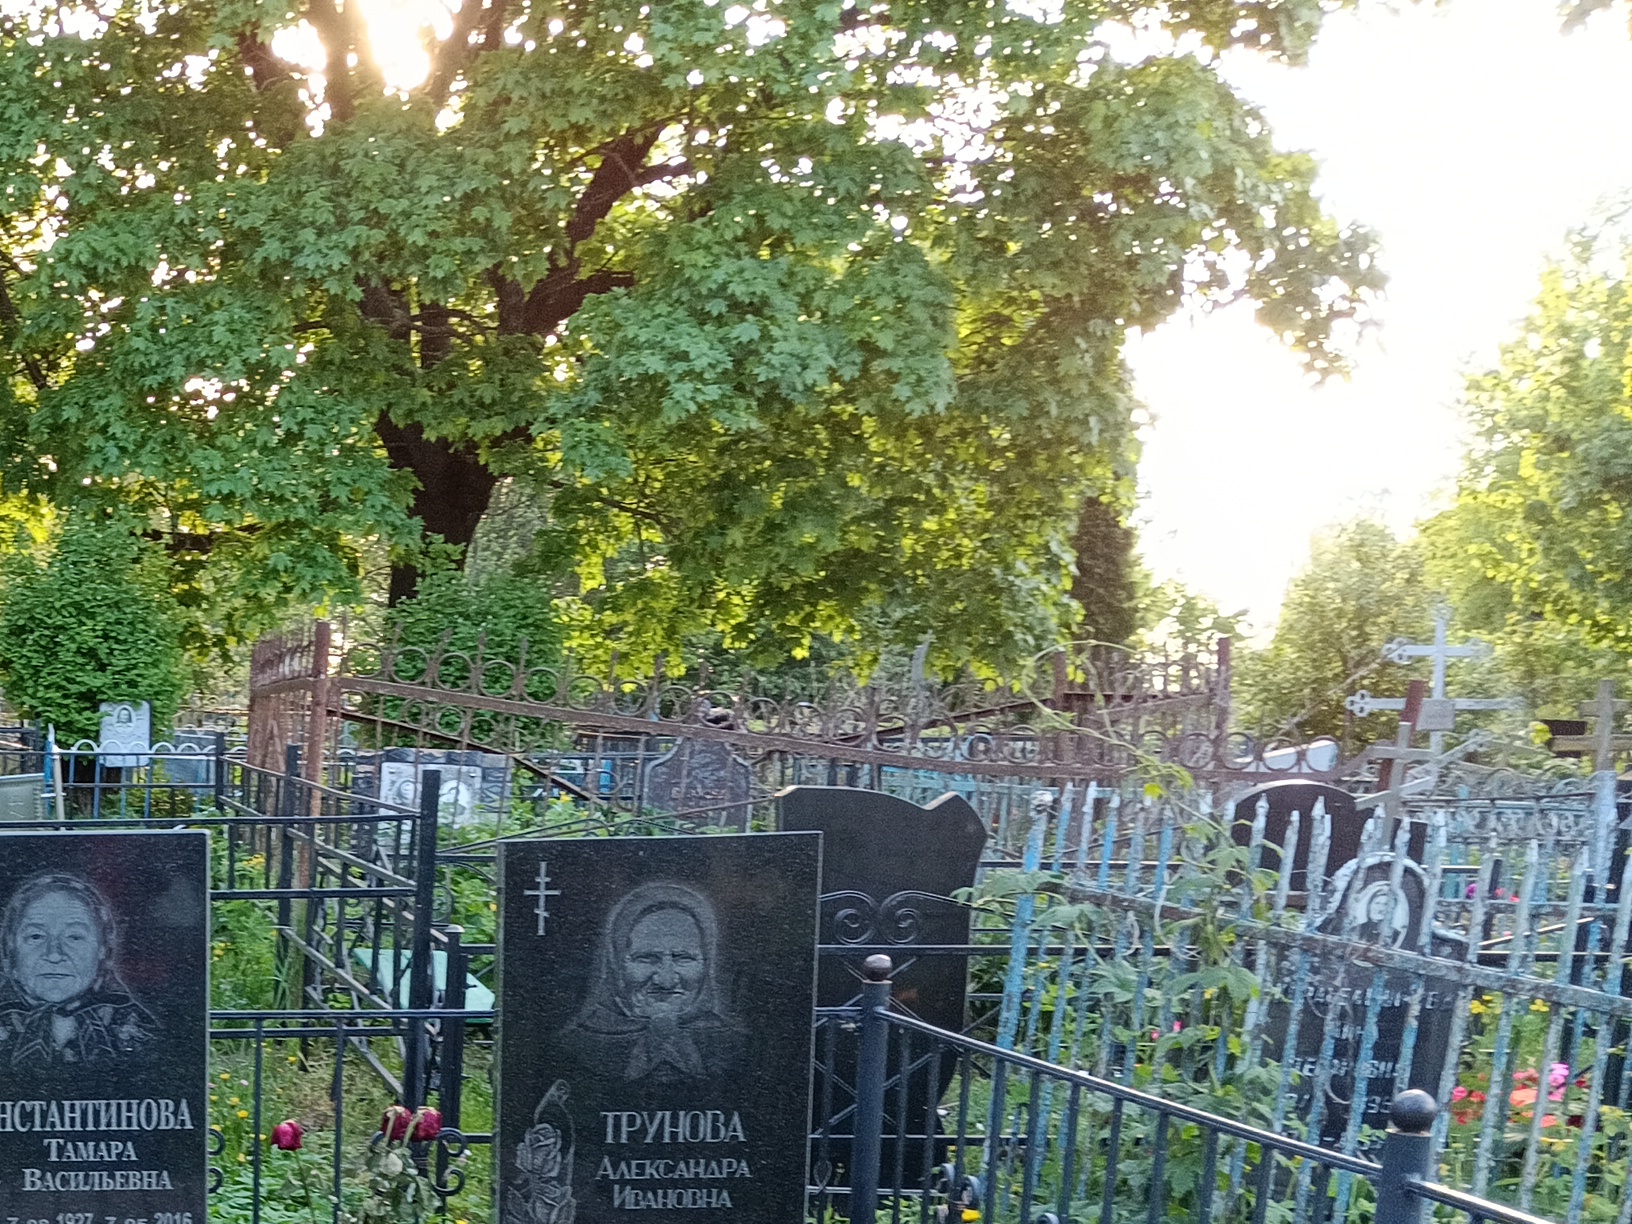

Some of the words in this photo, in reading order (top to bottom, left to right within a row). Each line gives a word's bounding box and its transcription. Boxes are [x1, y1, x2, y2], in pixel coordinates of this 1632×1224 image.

[600, 1110, 748, 1144] ТРУНОВА
[43, 1138, 138, 1162] ТАМАРА
[21, 1168, 174, 1191] ВАСИЛЬЕВНА
[595, 1155, 753, 1180] АЛЕКСАНДРА
[612, 1184, 733, 1210] ИВАНОВНА
